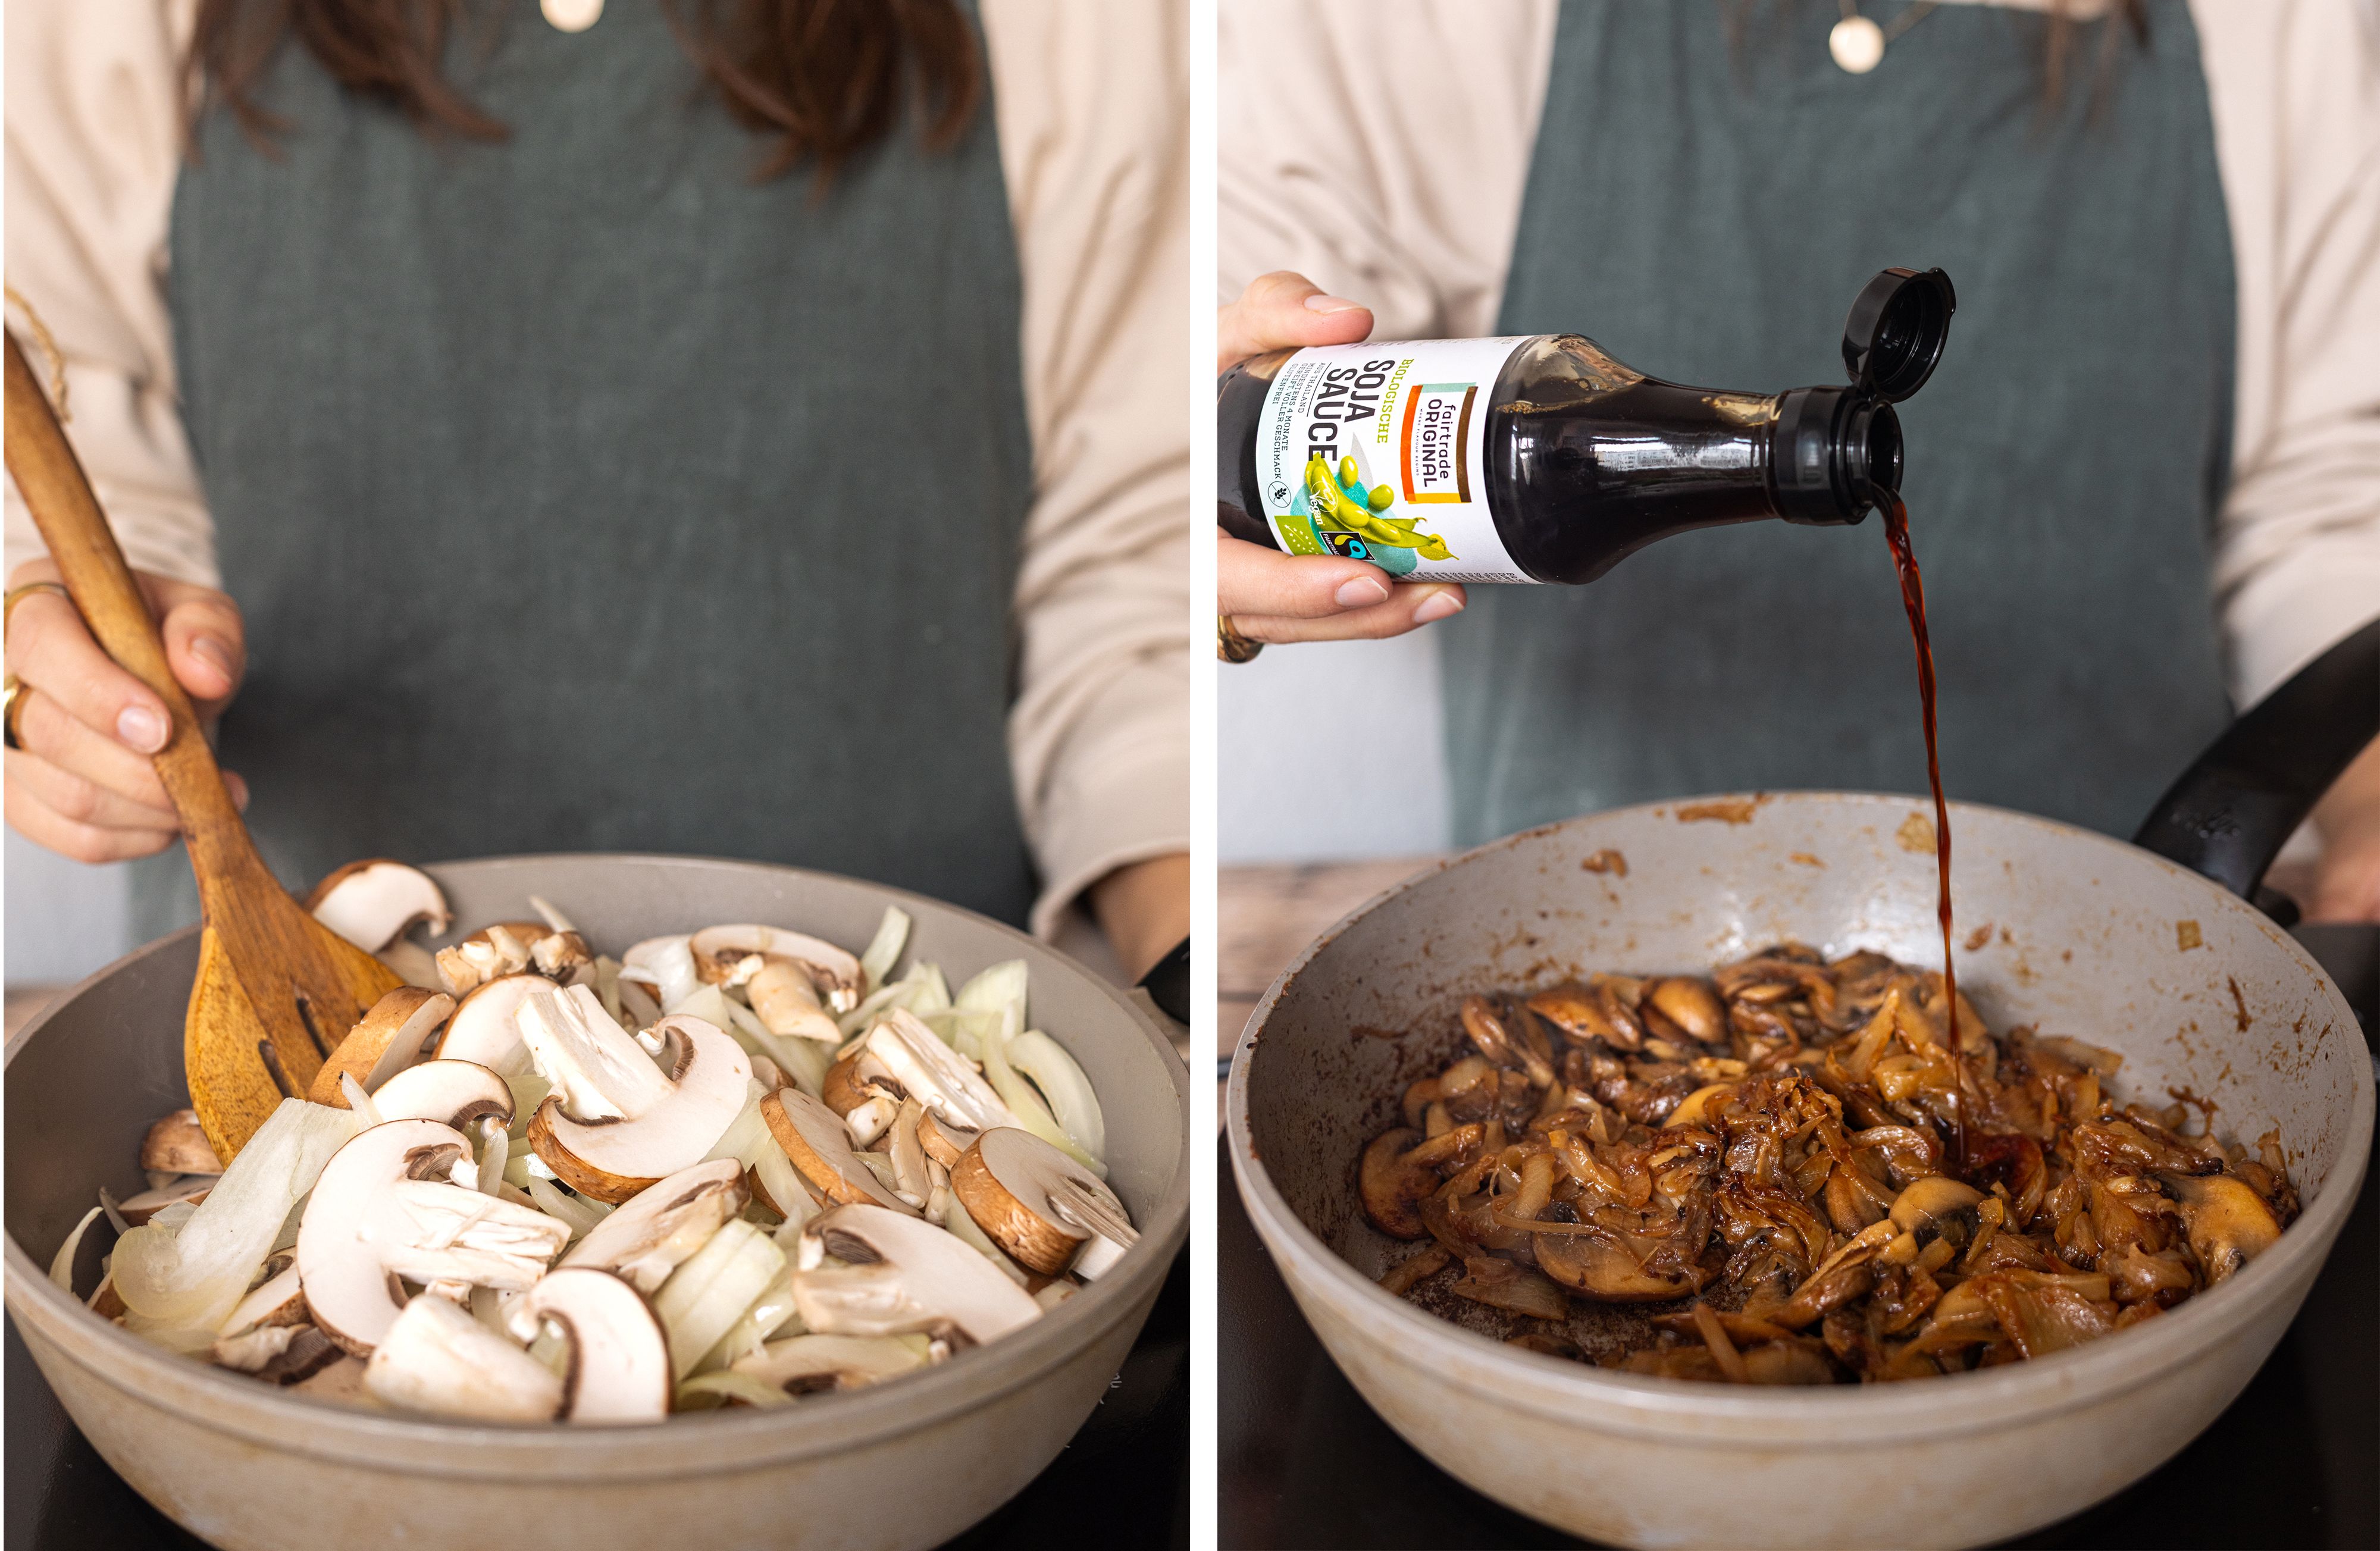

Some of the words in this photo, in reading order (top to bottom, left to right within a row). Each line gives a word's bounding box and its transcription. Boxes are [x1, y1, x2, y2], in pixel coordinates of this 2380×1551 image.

[1272, 363, 1299, 405] GLUTENFREI
[1286, 363, 1308, 390] GEREIFT.
[1289, 362, 1316, 406] MINDESTENS
[1314, 362, 1326, 374] AUS
[1277, 391, 1292, 422] VOLLER
[1298, 375, 1318, 413] THAILAND
[1344, 360, 1395, 423] SOJA
[1377, 359, 1414, 443] BIOLOGISCHE
[1282, 415, 1292, 451] MONATE
[1308, 368, 1358, 462] SAUCE
[1273, 425, 1283, 479] GESCHMACK
[1422, 399, 1442, 487] ORIGINAL
[1439, 405, 1456, 479] fairtrade
[1309, 490, 1326, 525] Vegan
